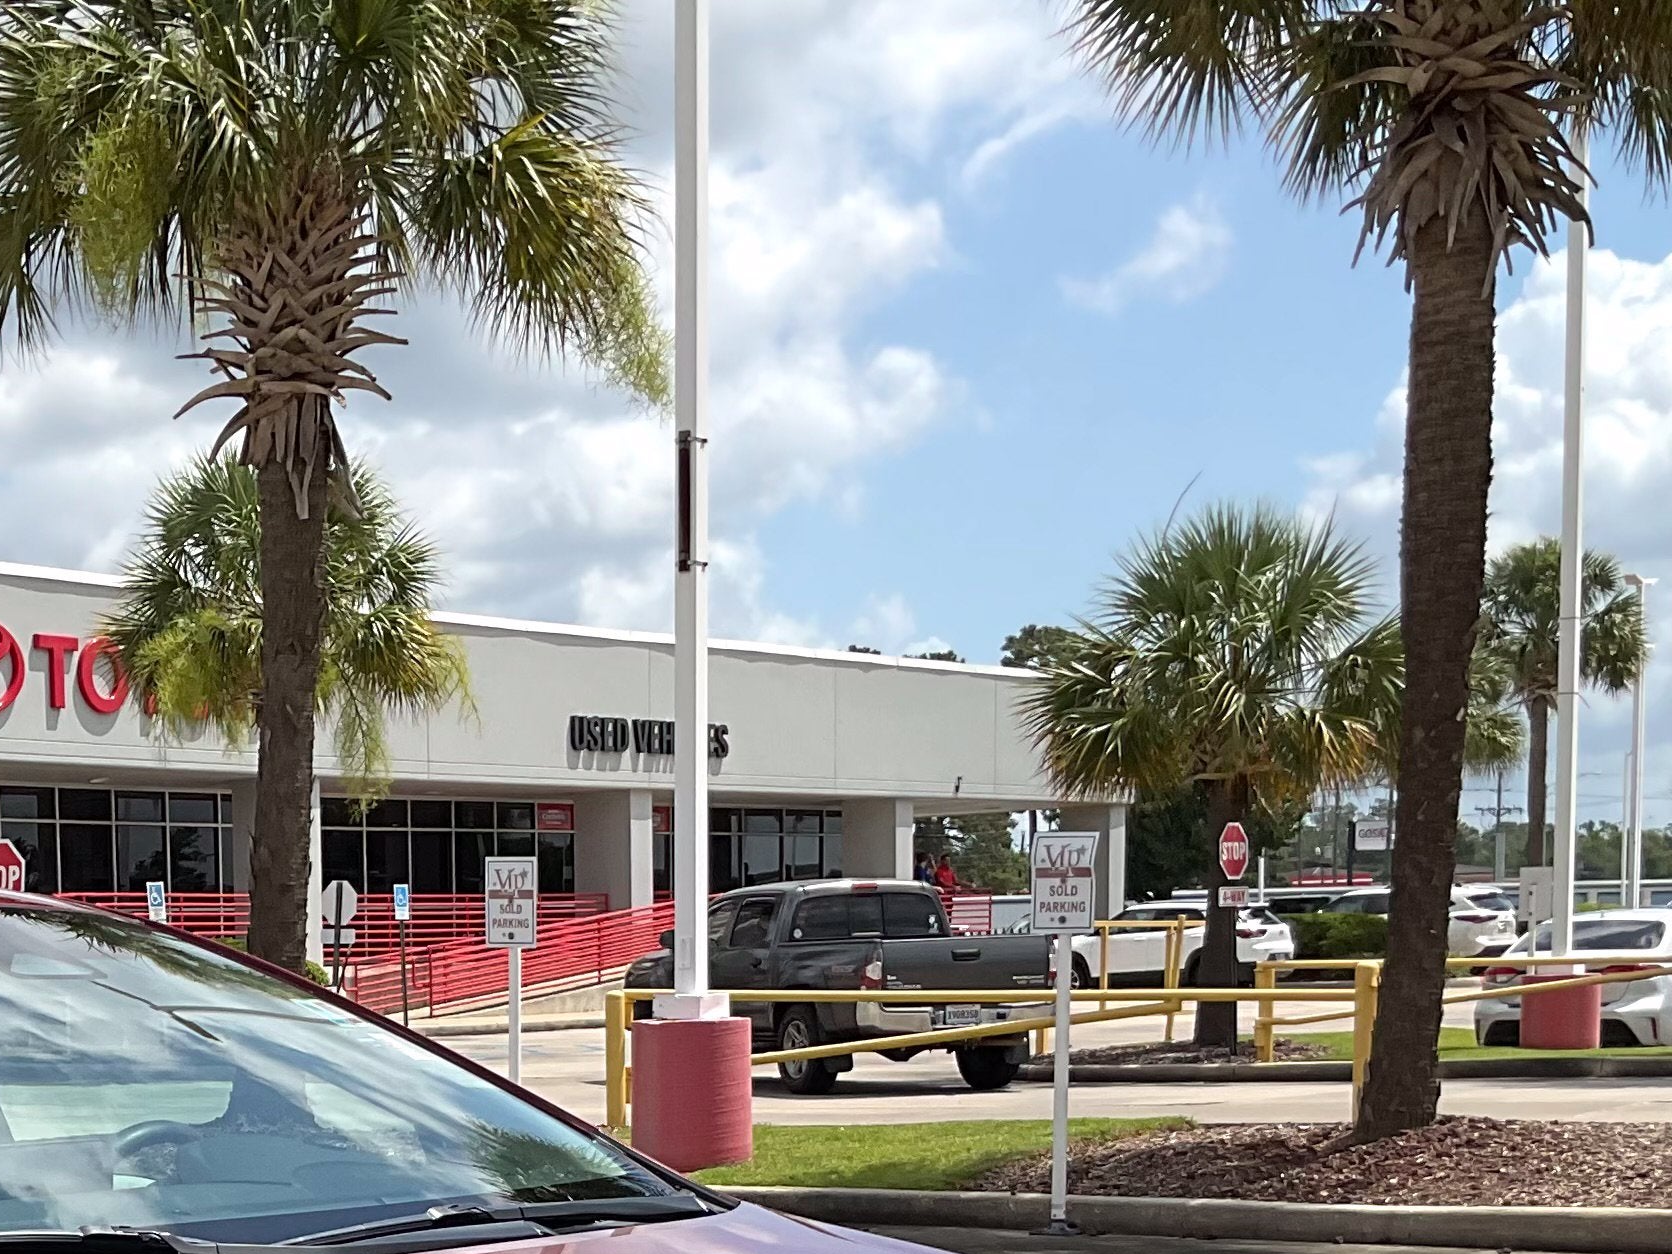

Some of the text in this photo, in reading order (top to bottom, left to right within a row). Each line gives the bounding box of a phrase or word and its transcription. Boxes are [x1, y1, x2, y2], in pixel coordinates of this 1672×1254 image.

[570, 716, 730, 758] USED VEHES
[1222, 842, 1246, 861] STOP
[1049, 885, 1078, 897] SOLD
[499, 904, 523, 915] SOLD
[1039, 901, 1086, 913] PARKING
[492, 918, 530, 929] PARKING
